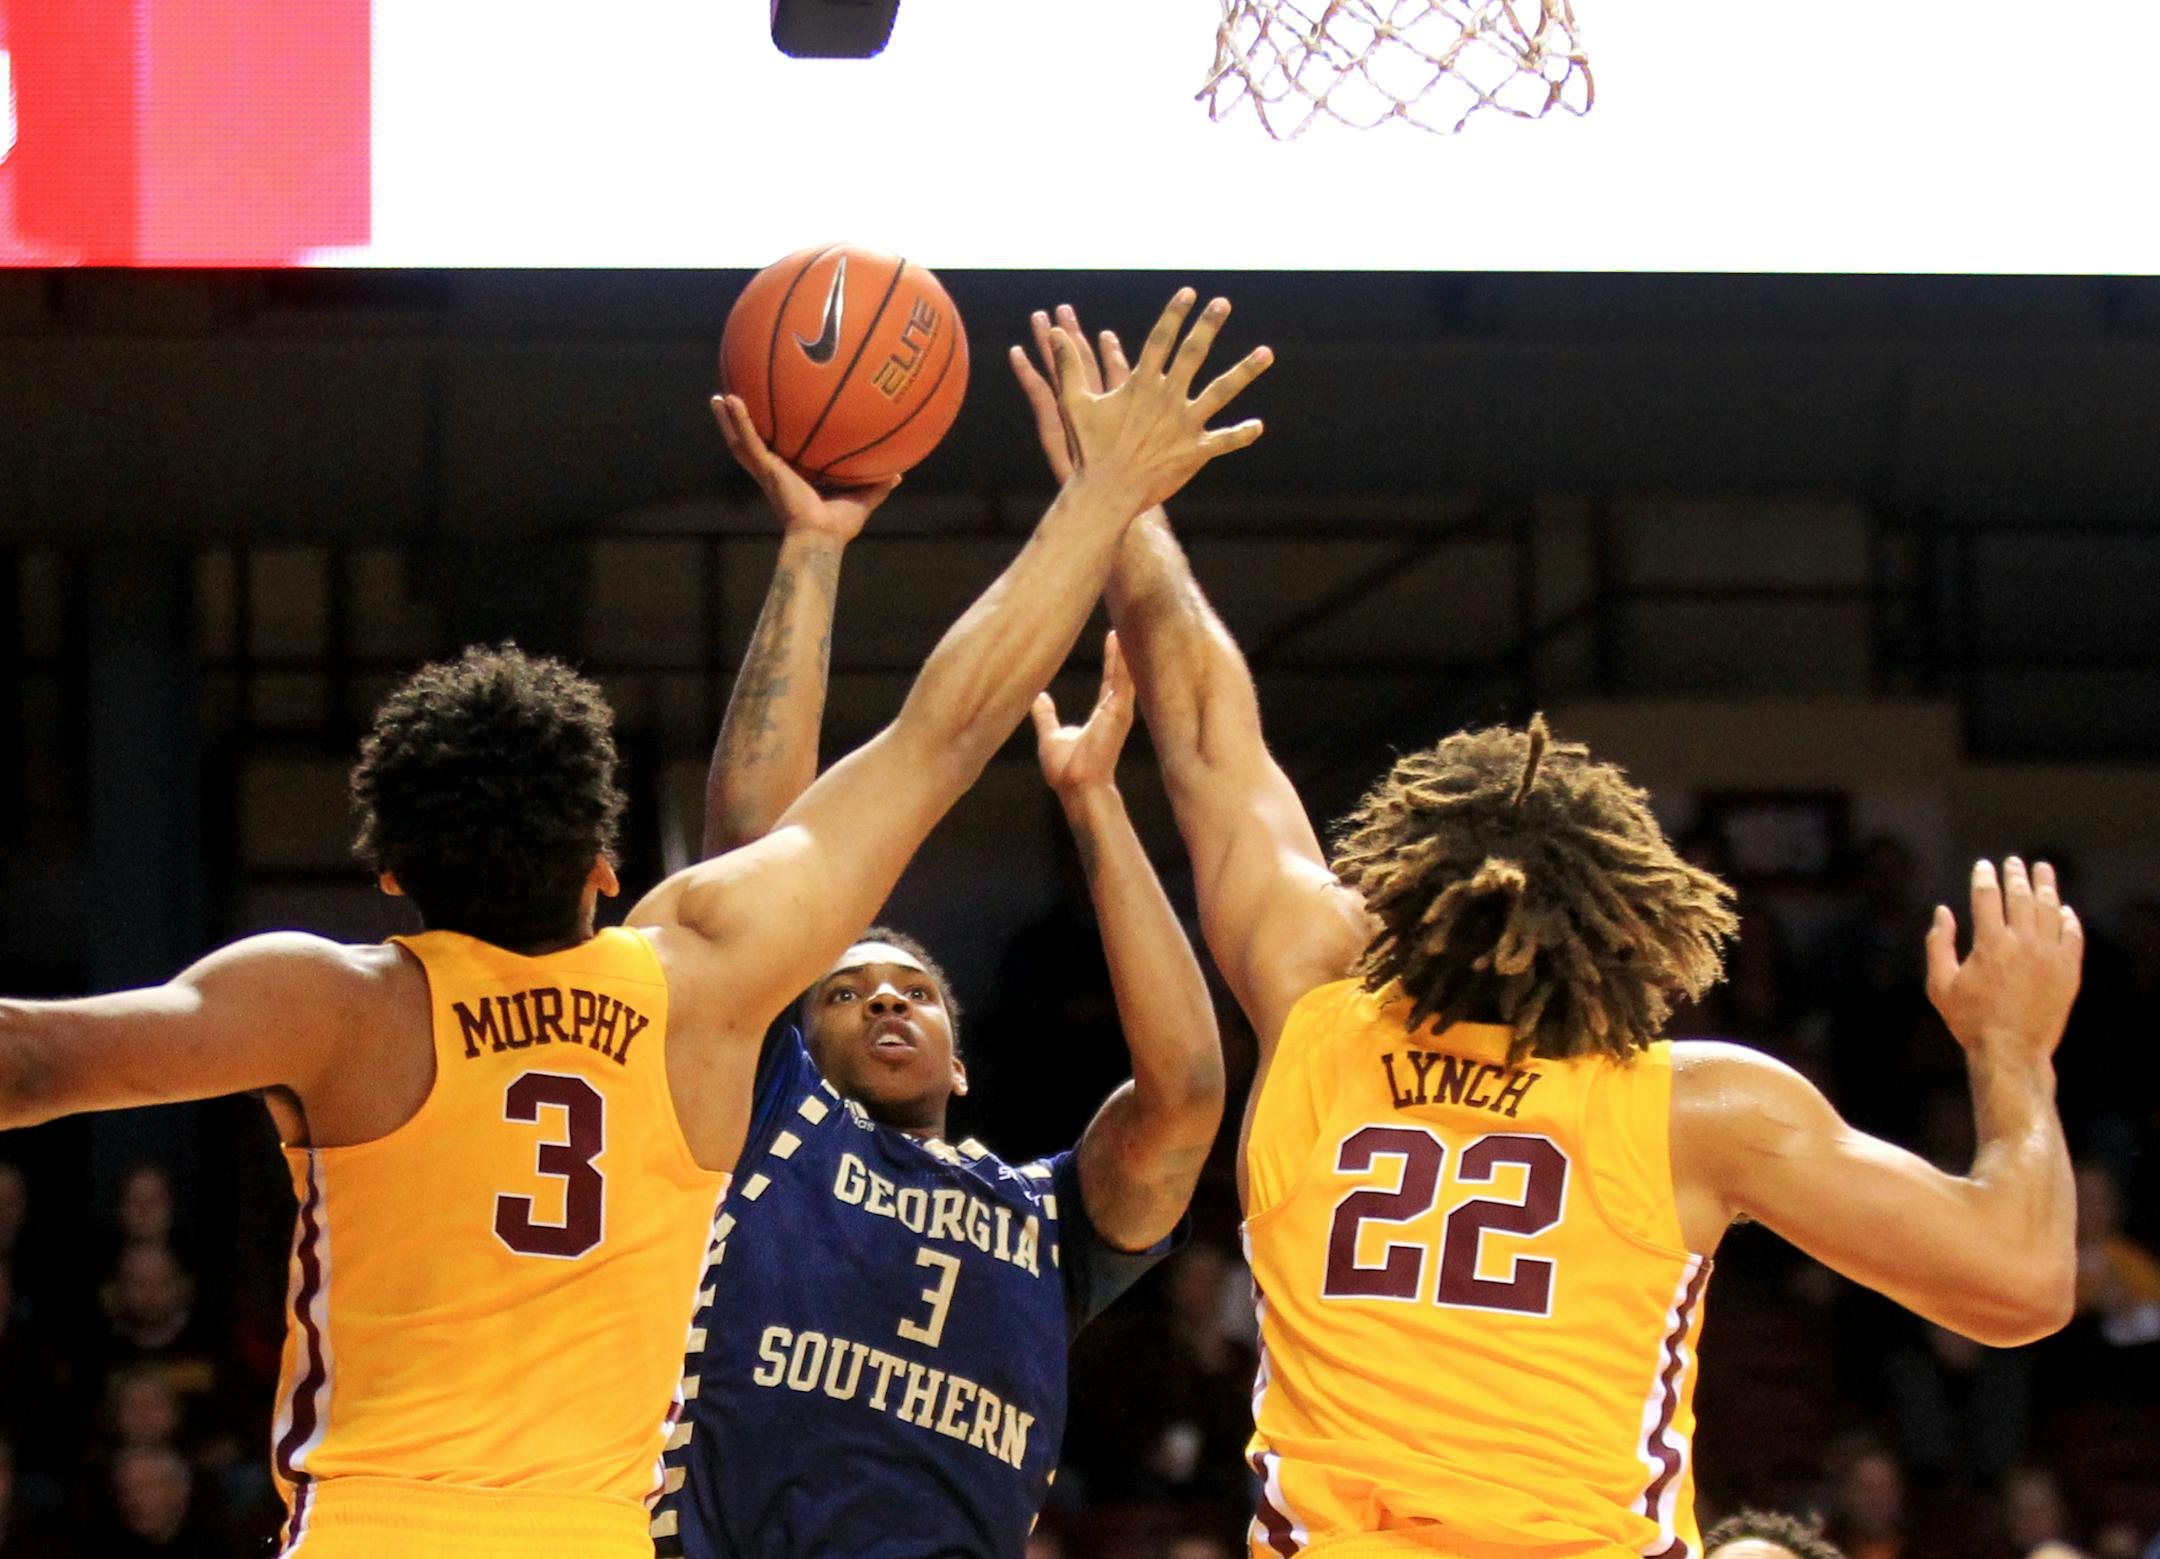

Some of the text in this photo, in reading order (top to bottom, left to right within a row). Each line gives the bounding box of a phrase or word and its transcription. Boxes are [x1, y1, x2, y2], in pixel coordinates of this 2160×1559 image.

[870, 297, 937, 398] ELITE
[452, 986, 650, 1066] MURPHY
[1381, 1050, 1542, 1119] LYNCH
[492, 1068, 606, 1261] 3
[832, 1152, 1041, 1279] GEORGIA
[1321, 1123, 1571, 1319] 22
[896, 1246, 961, 1349] 3
[752, 1325, 1036, 1471] SOUTHERN
